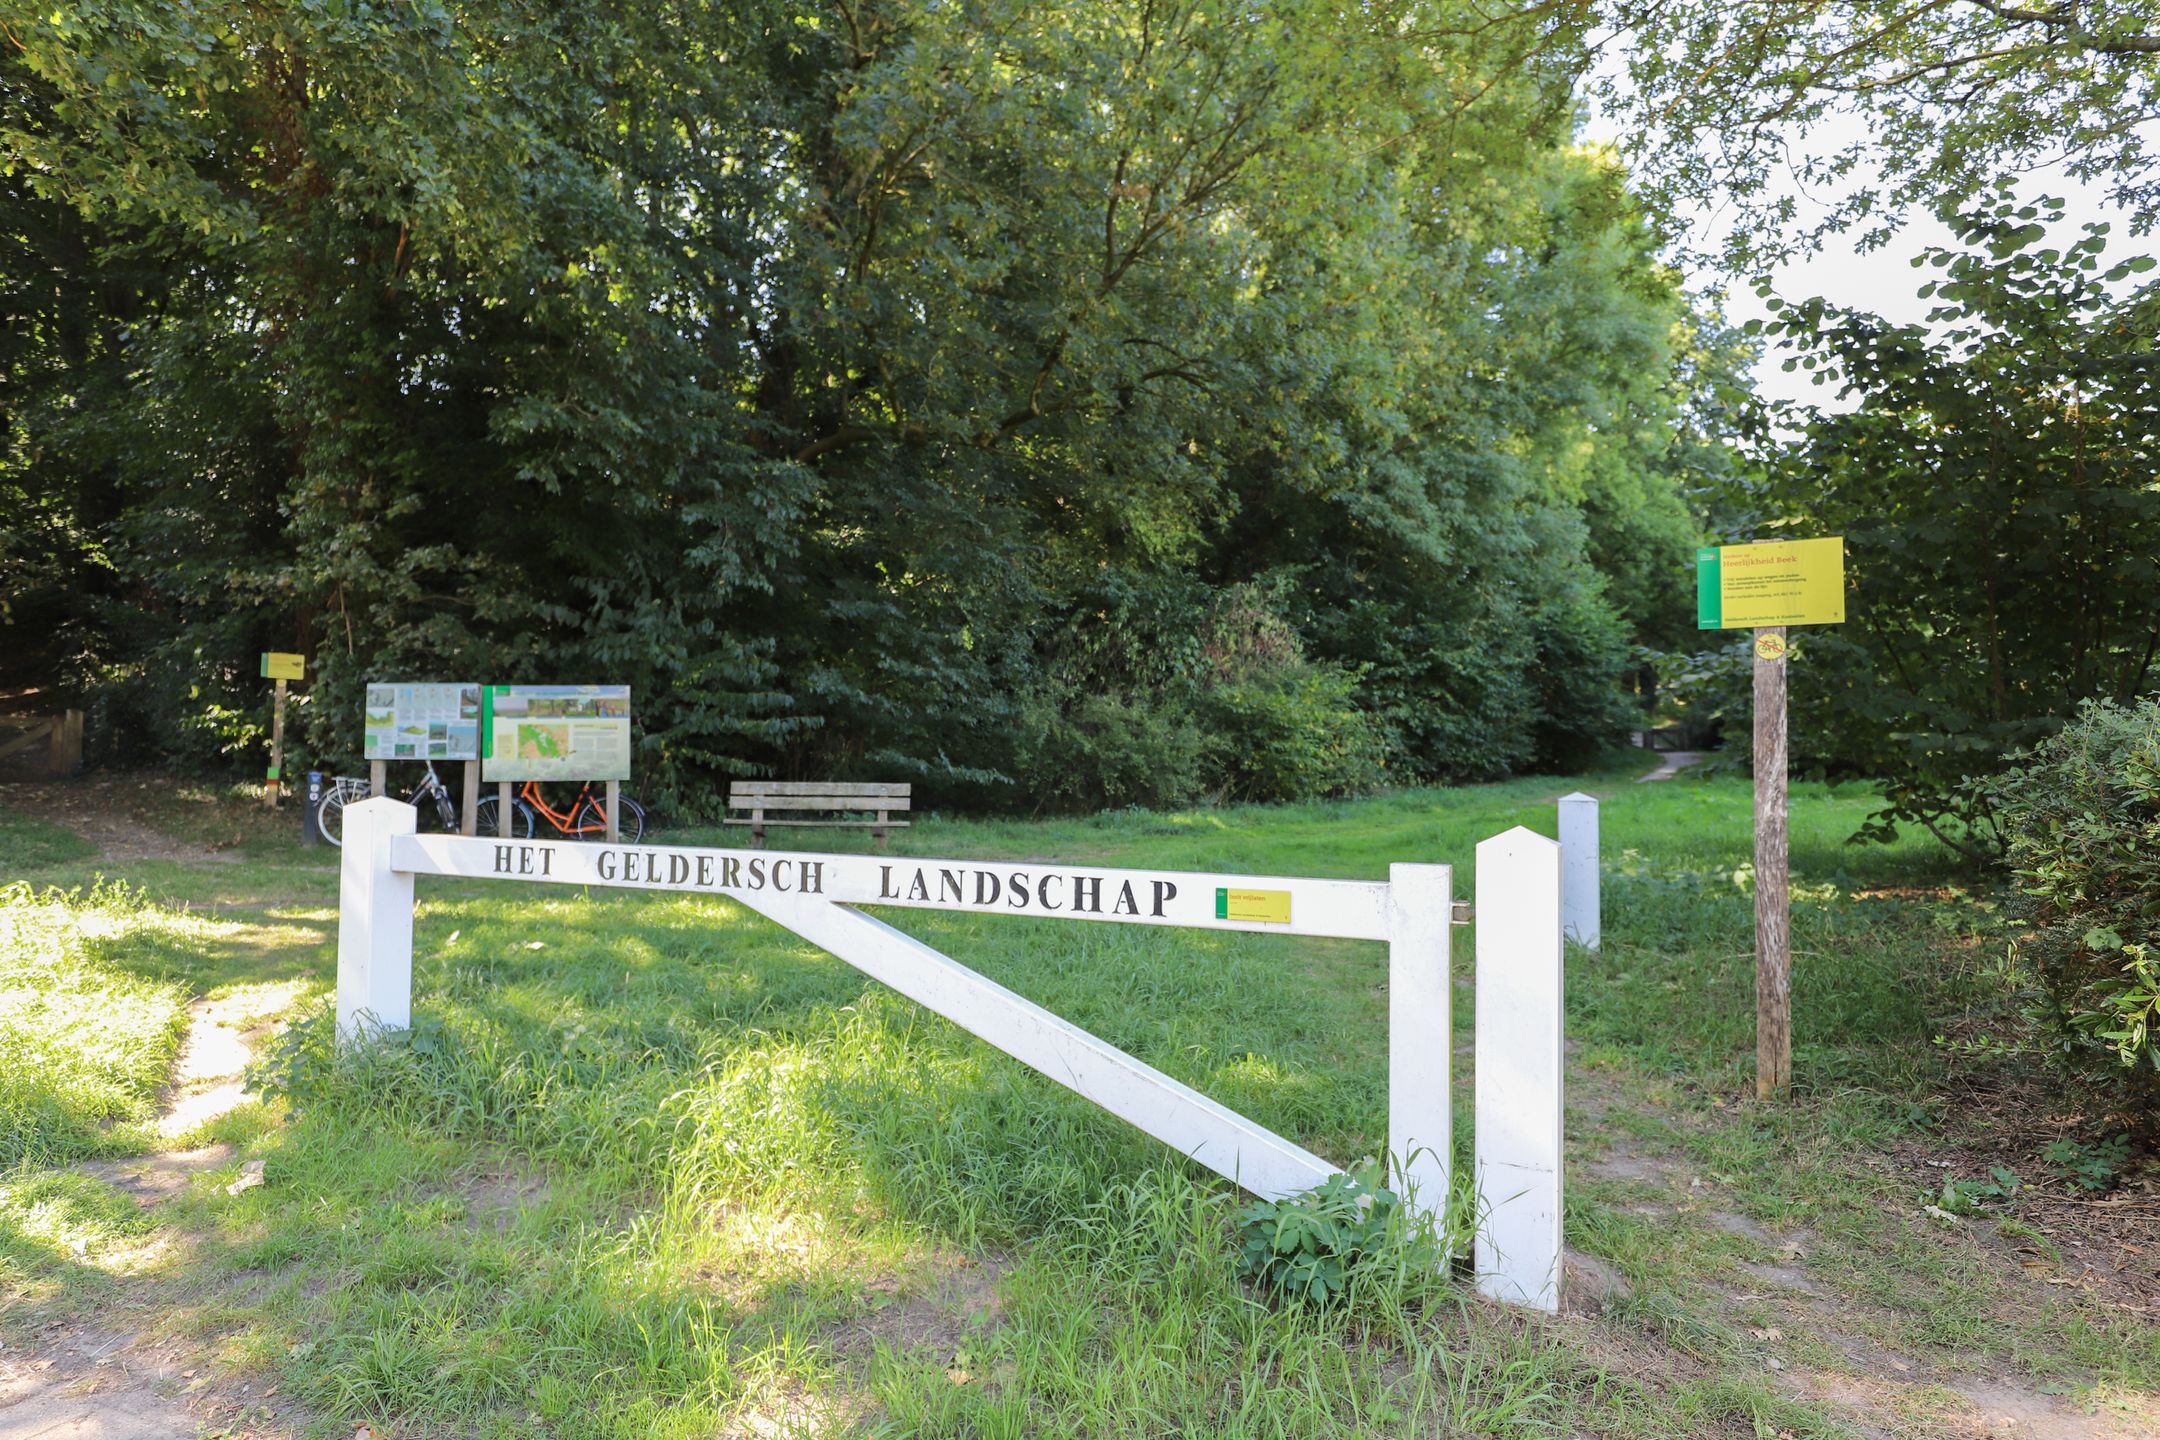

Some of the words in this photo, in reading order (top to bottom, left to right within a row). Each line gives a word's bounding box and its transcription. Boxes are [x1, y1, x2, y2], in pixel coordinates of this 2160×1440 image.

[1776, 555, 1798, 564] Beek
[493, 844, 556, 876] HET
[597, 850, 825, 894] GELDERSCH
[879, 865, 1178, 917] LANDSCHAP
